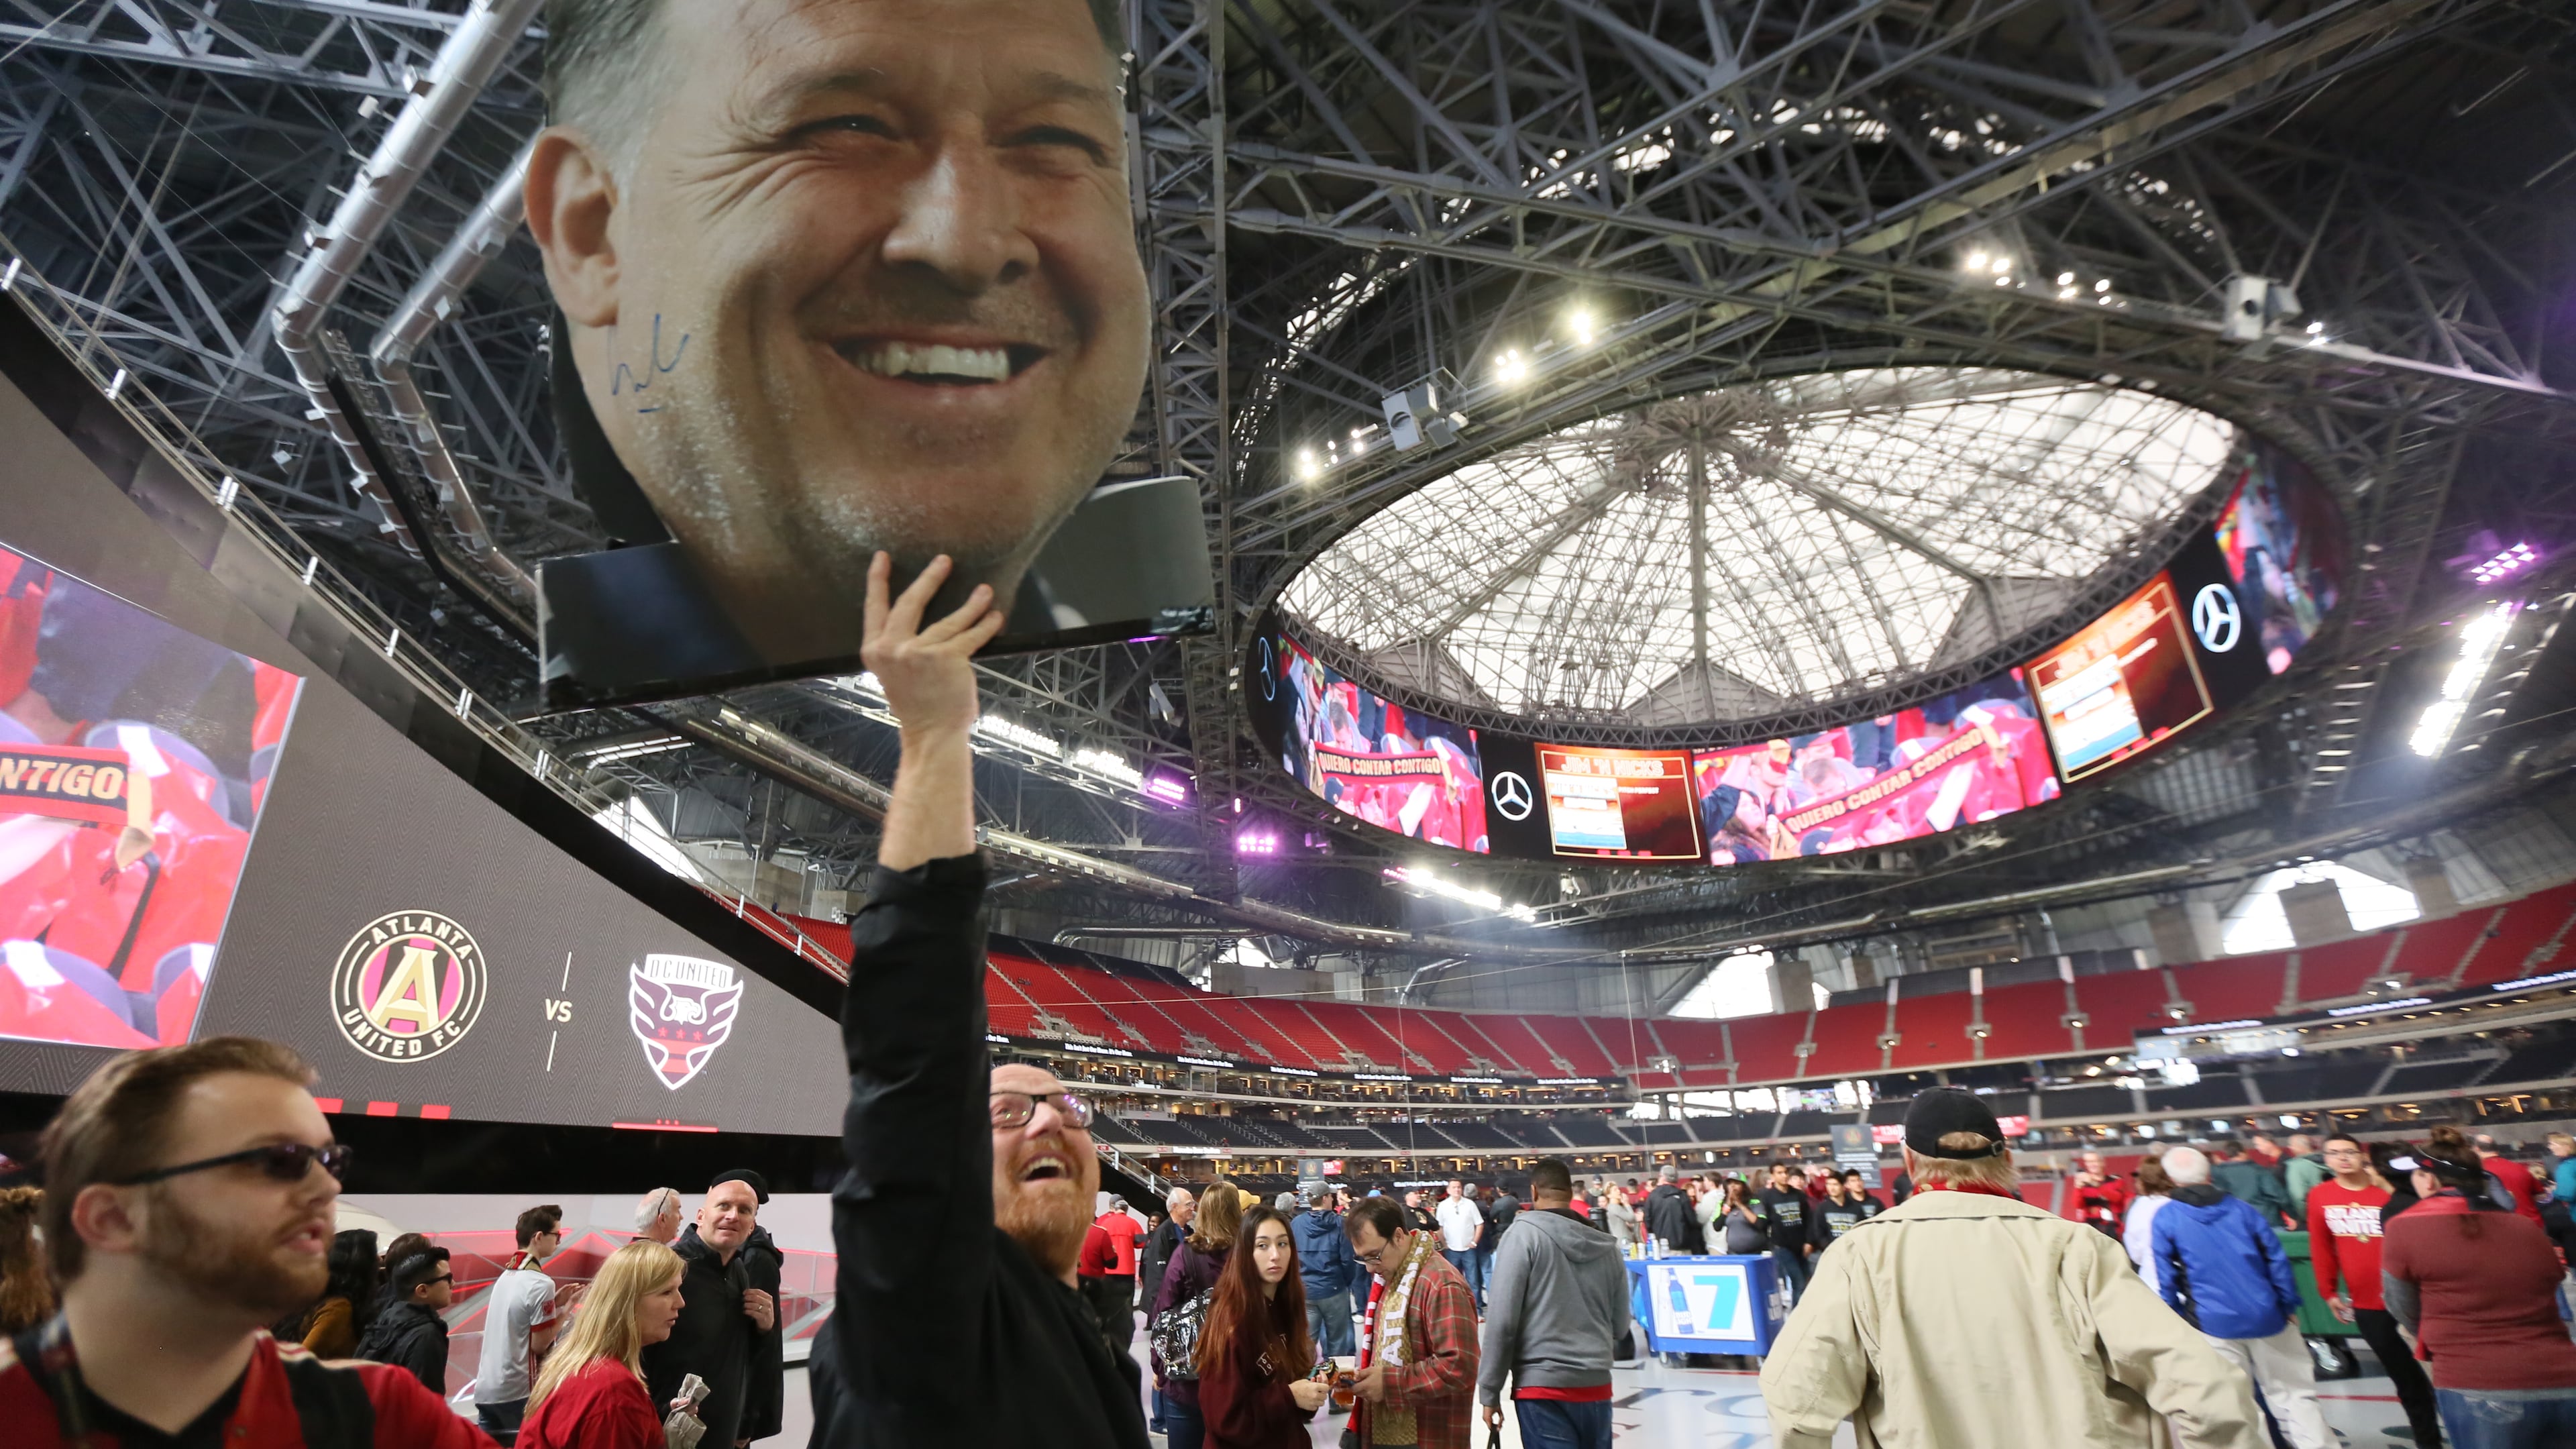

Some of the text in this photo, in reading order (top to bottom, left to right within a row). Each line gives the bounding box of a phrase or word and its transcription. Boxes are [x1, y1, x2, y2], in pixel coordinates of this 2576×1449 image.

[1319, 753, 1440, 775] QUIERO CONTAR CONTIGO
[1561, 756, 1591, 773] JIM
[1786, 728, 1984, 833] QUIERO CONTAR CONTIGO
[371, 916, 472, 959] ATLANTA
[676, 961, 727, 988] UNITED
[545, 998, 572, 1022] VS
[343, 1008, 460, 1057] UNITED FC
[2324, 1207, 2381, 1220] ATLANT
[2325, 1218, 2383, 1234] UNITE
[1693, 1275, 1741, 1330] 7
